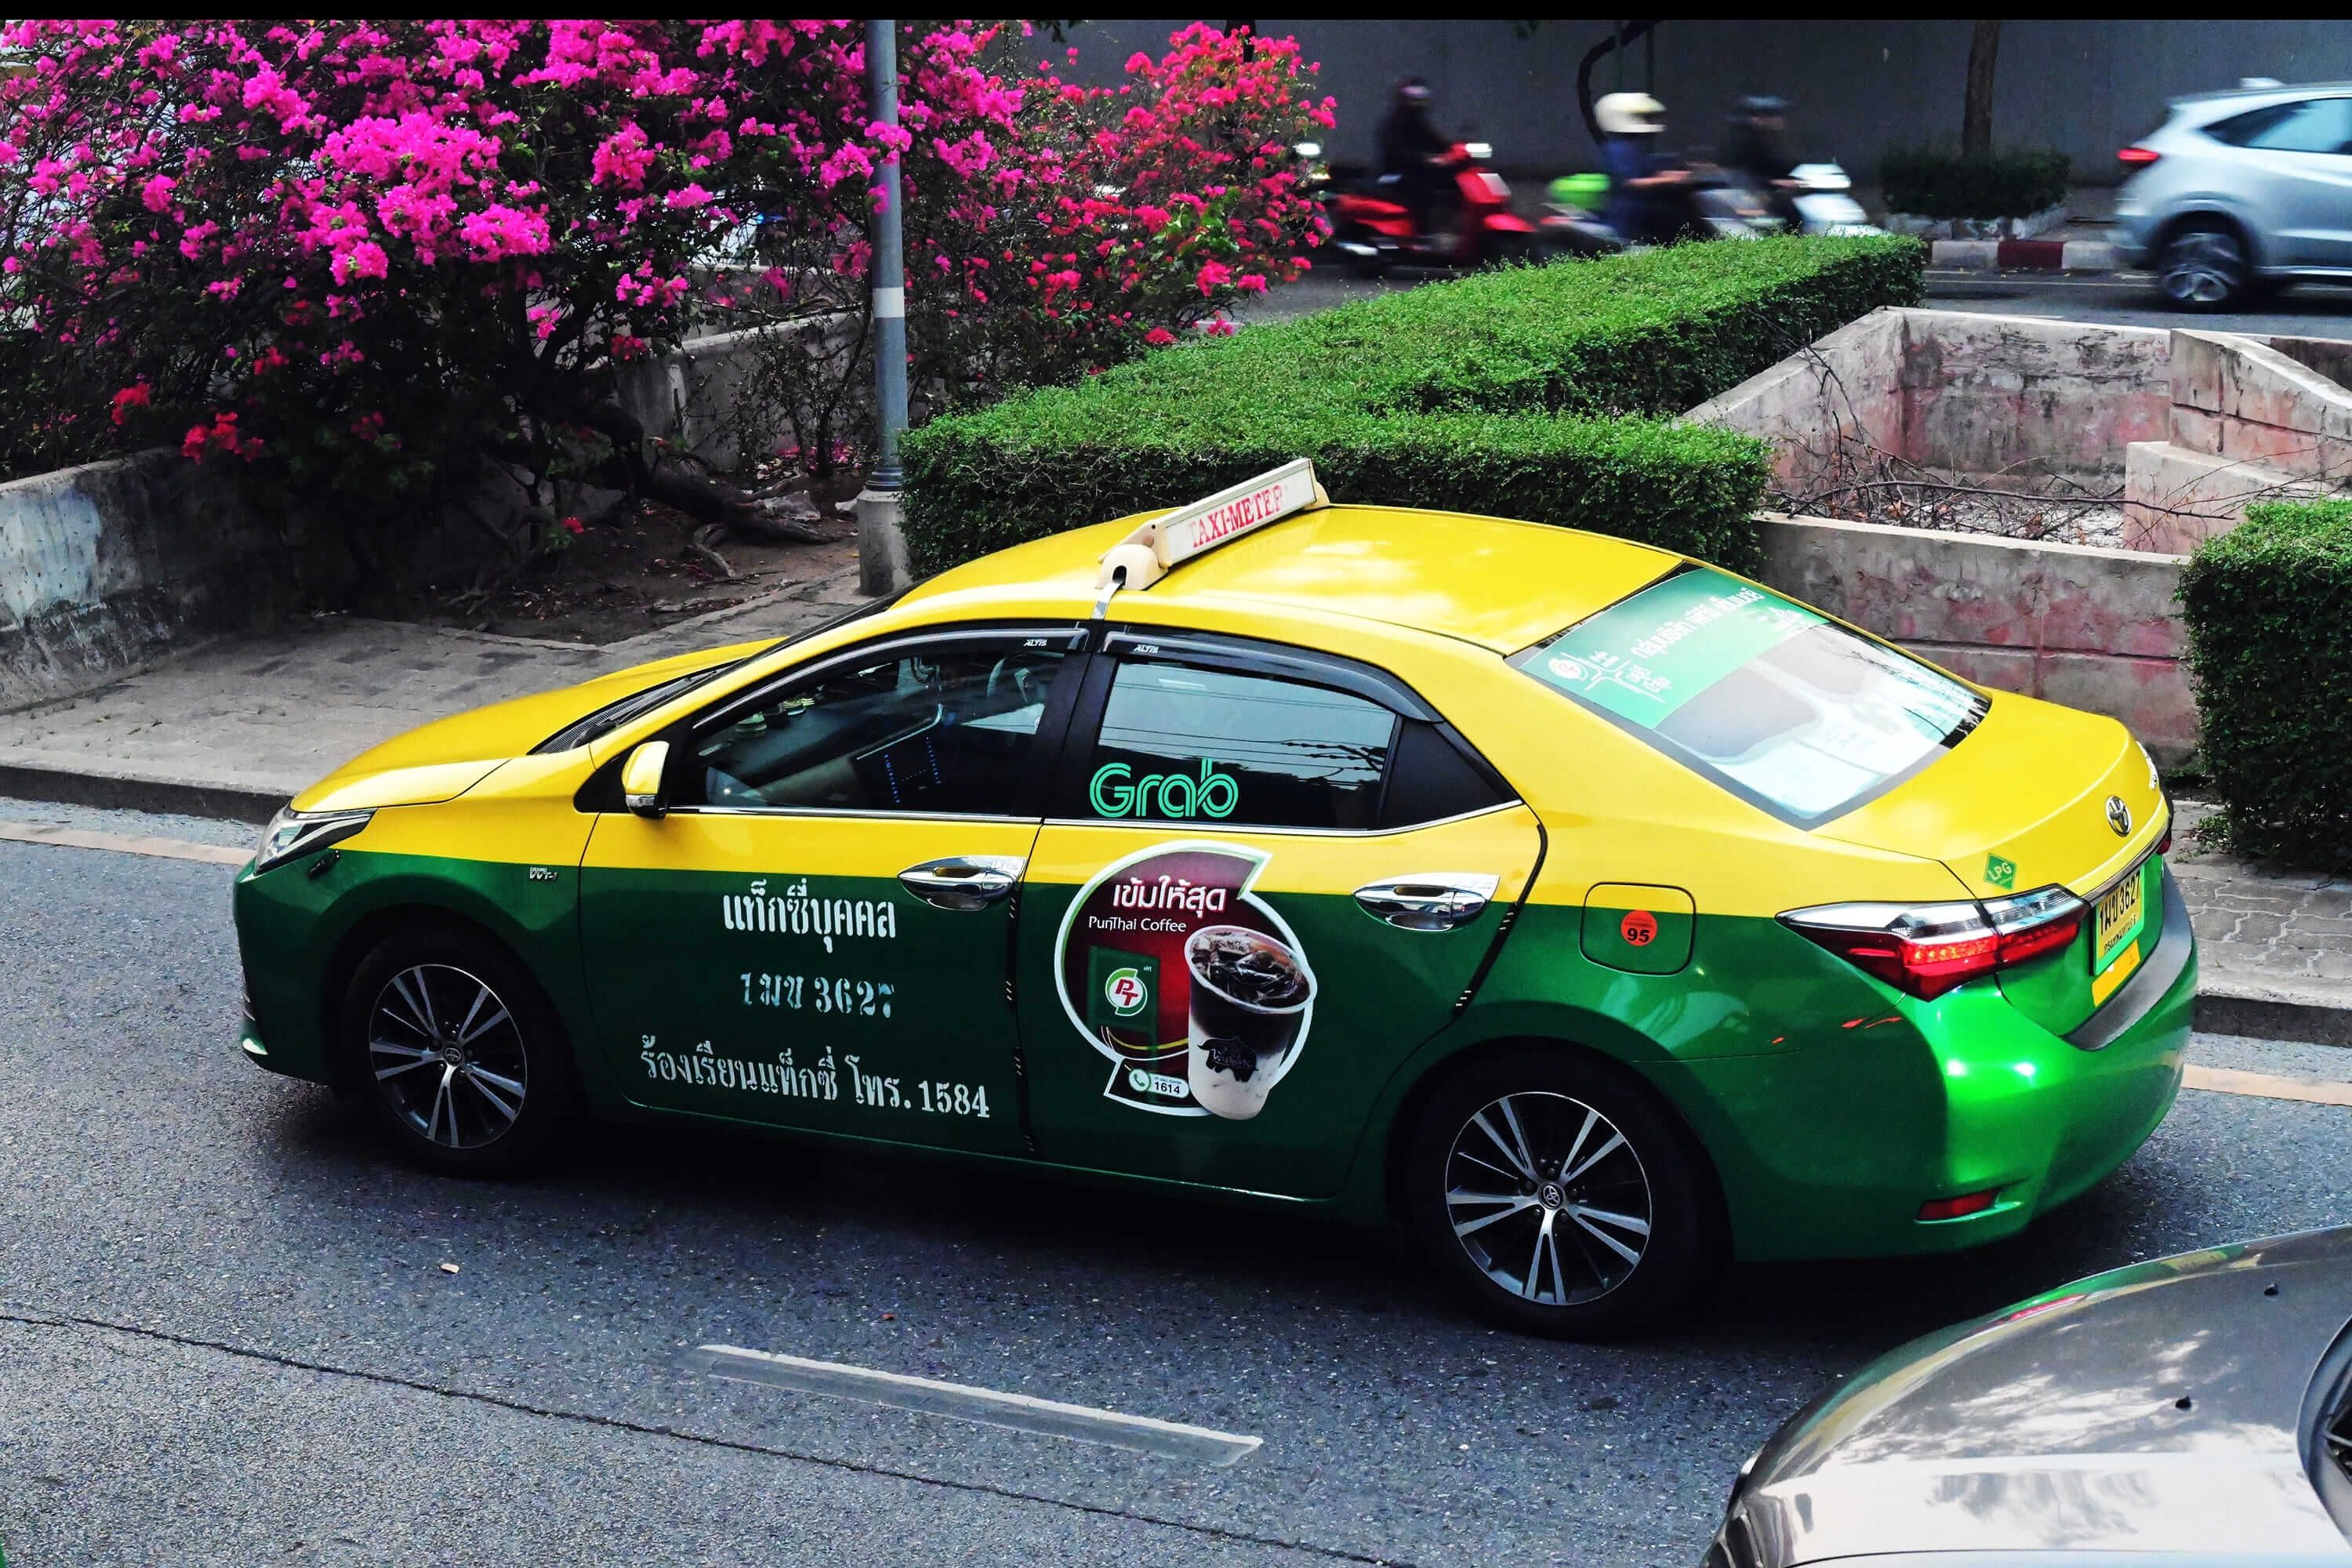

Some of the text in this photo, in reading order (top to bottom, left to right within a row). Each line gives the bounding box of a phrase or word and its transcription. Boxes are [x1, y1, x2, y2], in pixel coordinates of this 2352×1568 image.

[1090, 758, 1239, 817] Grab
[1987, 862, 2012, 881] LPG
[723, 877, 896, 953] แท็กซี่บุคคล
[1112, 875, 1225, 918] เข้มให้สุด
[1088, 916, 1187, 933] PunThai Coffee
[1627, 927, 1650, 943] 95
[814, 977, 895, 1018] 3627
[641, 1035, 838, 1101] ร้องเรียนแท็กซี่
[918, 1080, 990, 1118] 1584
[1154, 1081, 1181, 1094] 1614
